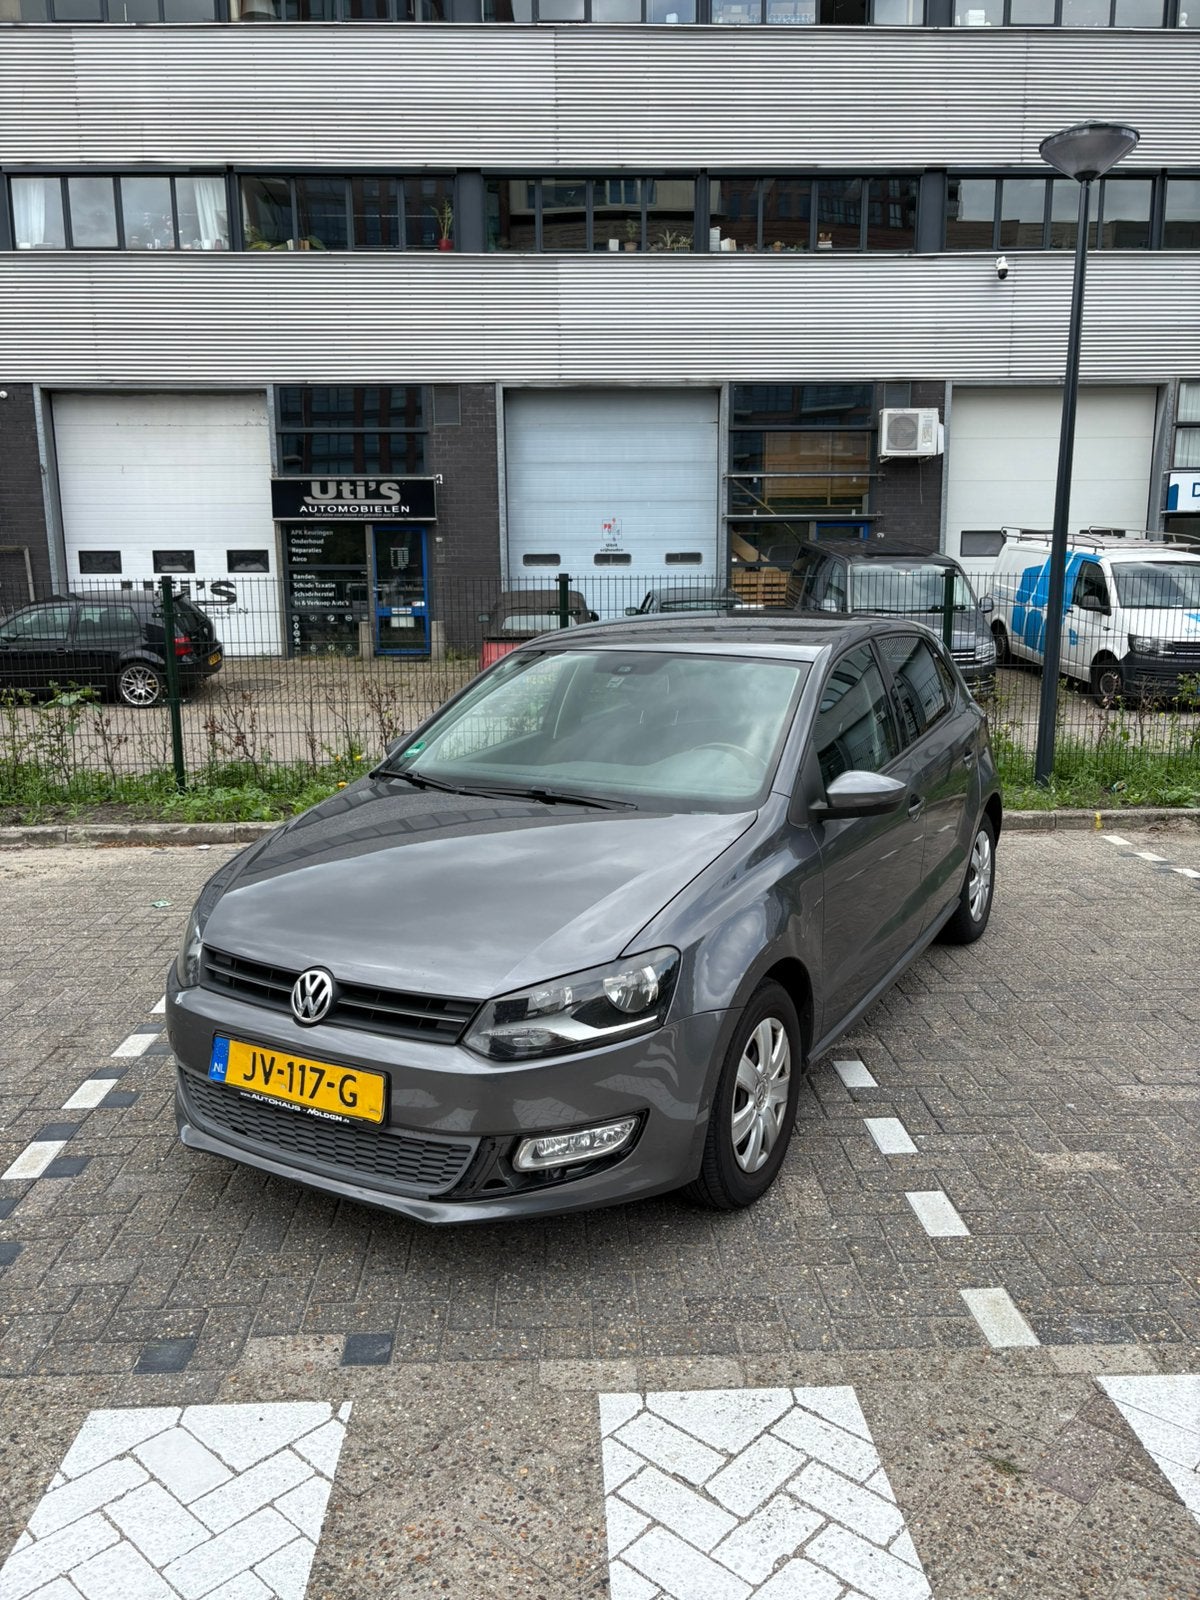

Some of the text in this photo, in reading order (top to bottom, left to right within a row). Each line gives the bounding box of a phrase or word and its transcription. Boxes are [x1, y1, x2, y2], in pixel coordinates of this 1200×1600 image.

[299, 505, 410, 513] AUTOMOBIELEN
[213, 1062, 225, 1074] NL
[243, 1052, 358, 1108] JV-117-G
